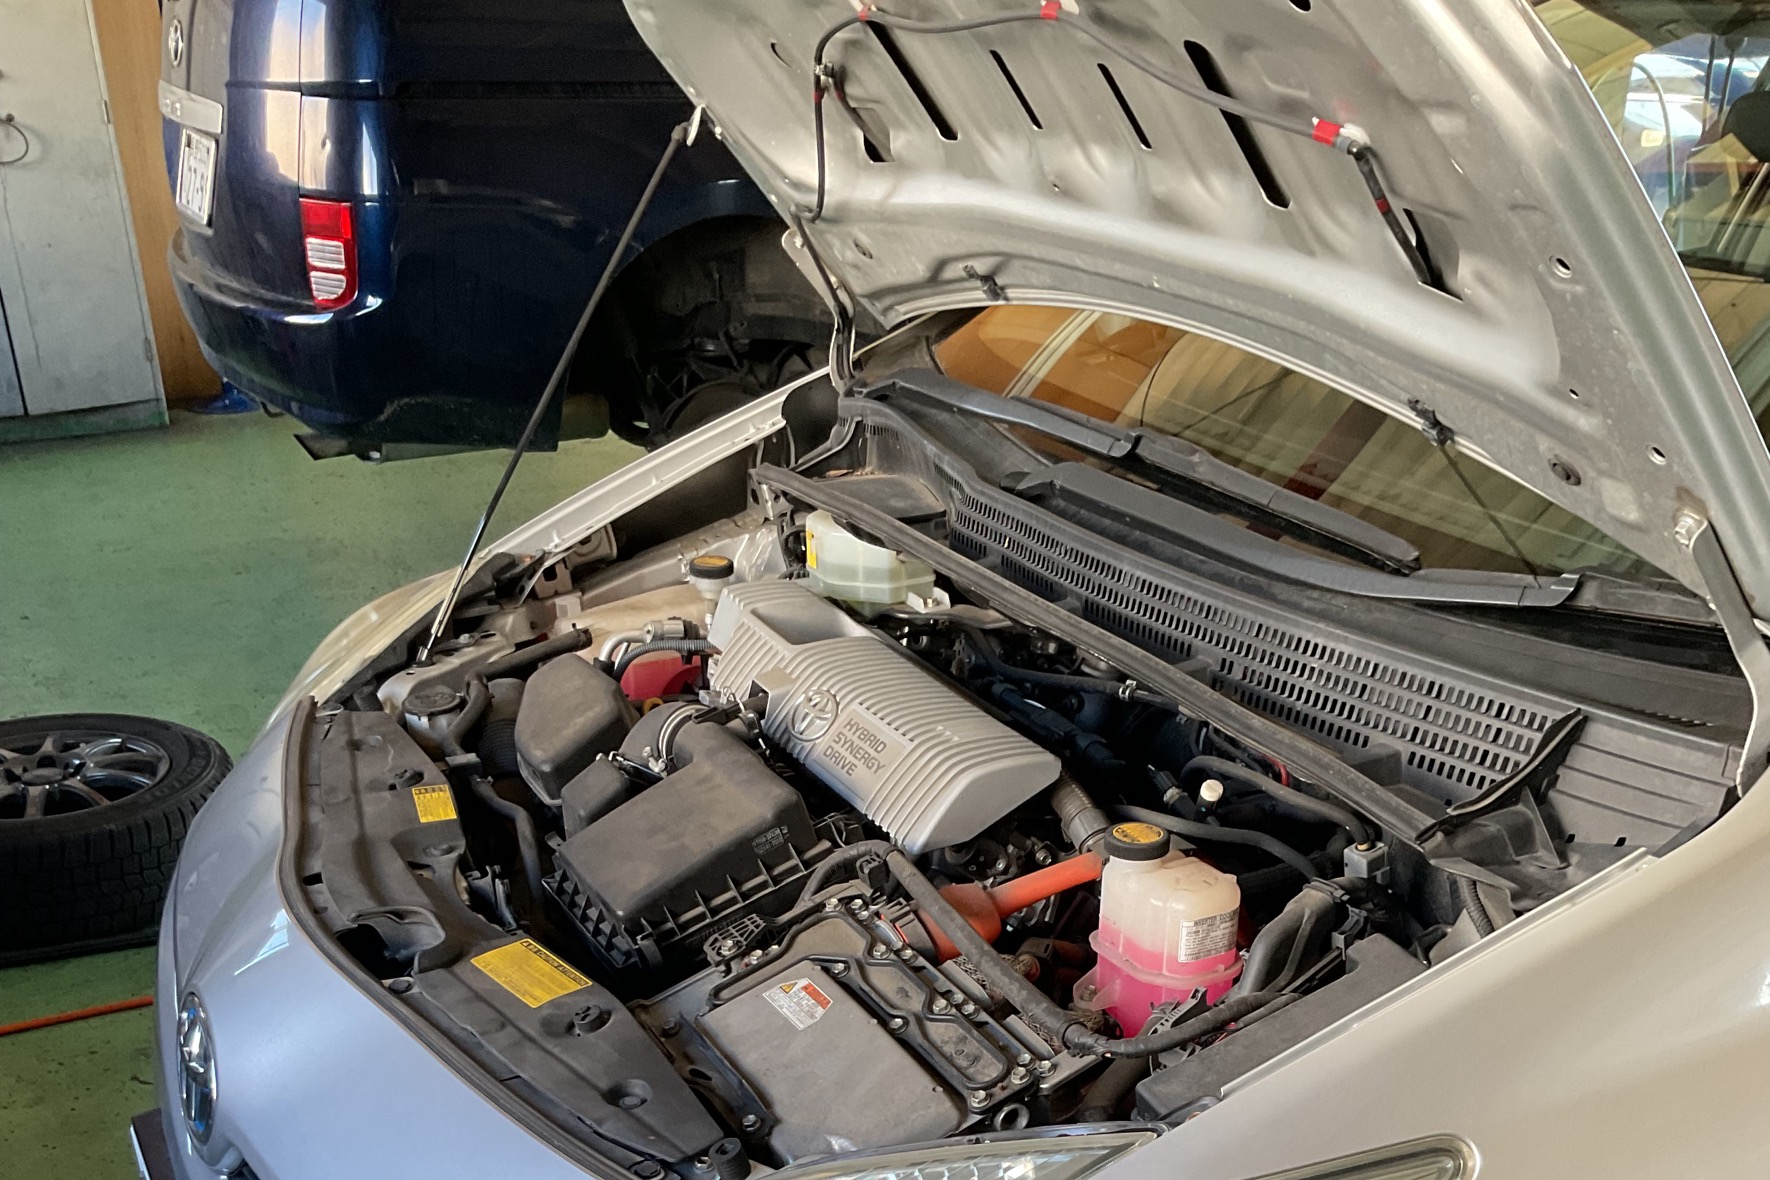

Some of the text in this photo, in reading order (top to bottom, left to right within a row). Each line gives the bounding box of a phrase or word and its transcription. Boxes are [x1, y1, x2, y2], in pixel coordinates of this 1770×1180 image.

[832, 732, 886, 774] SYNERGY
[843, 718, 887, 754] HYBRID
[823, 745, 858, 777] DRIVE
[1194, 915, 1217, 927] INVERTER
